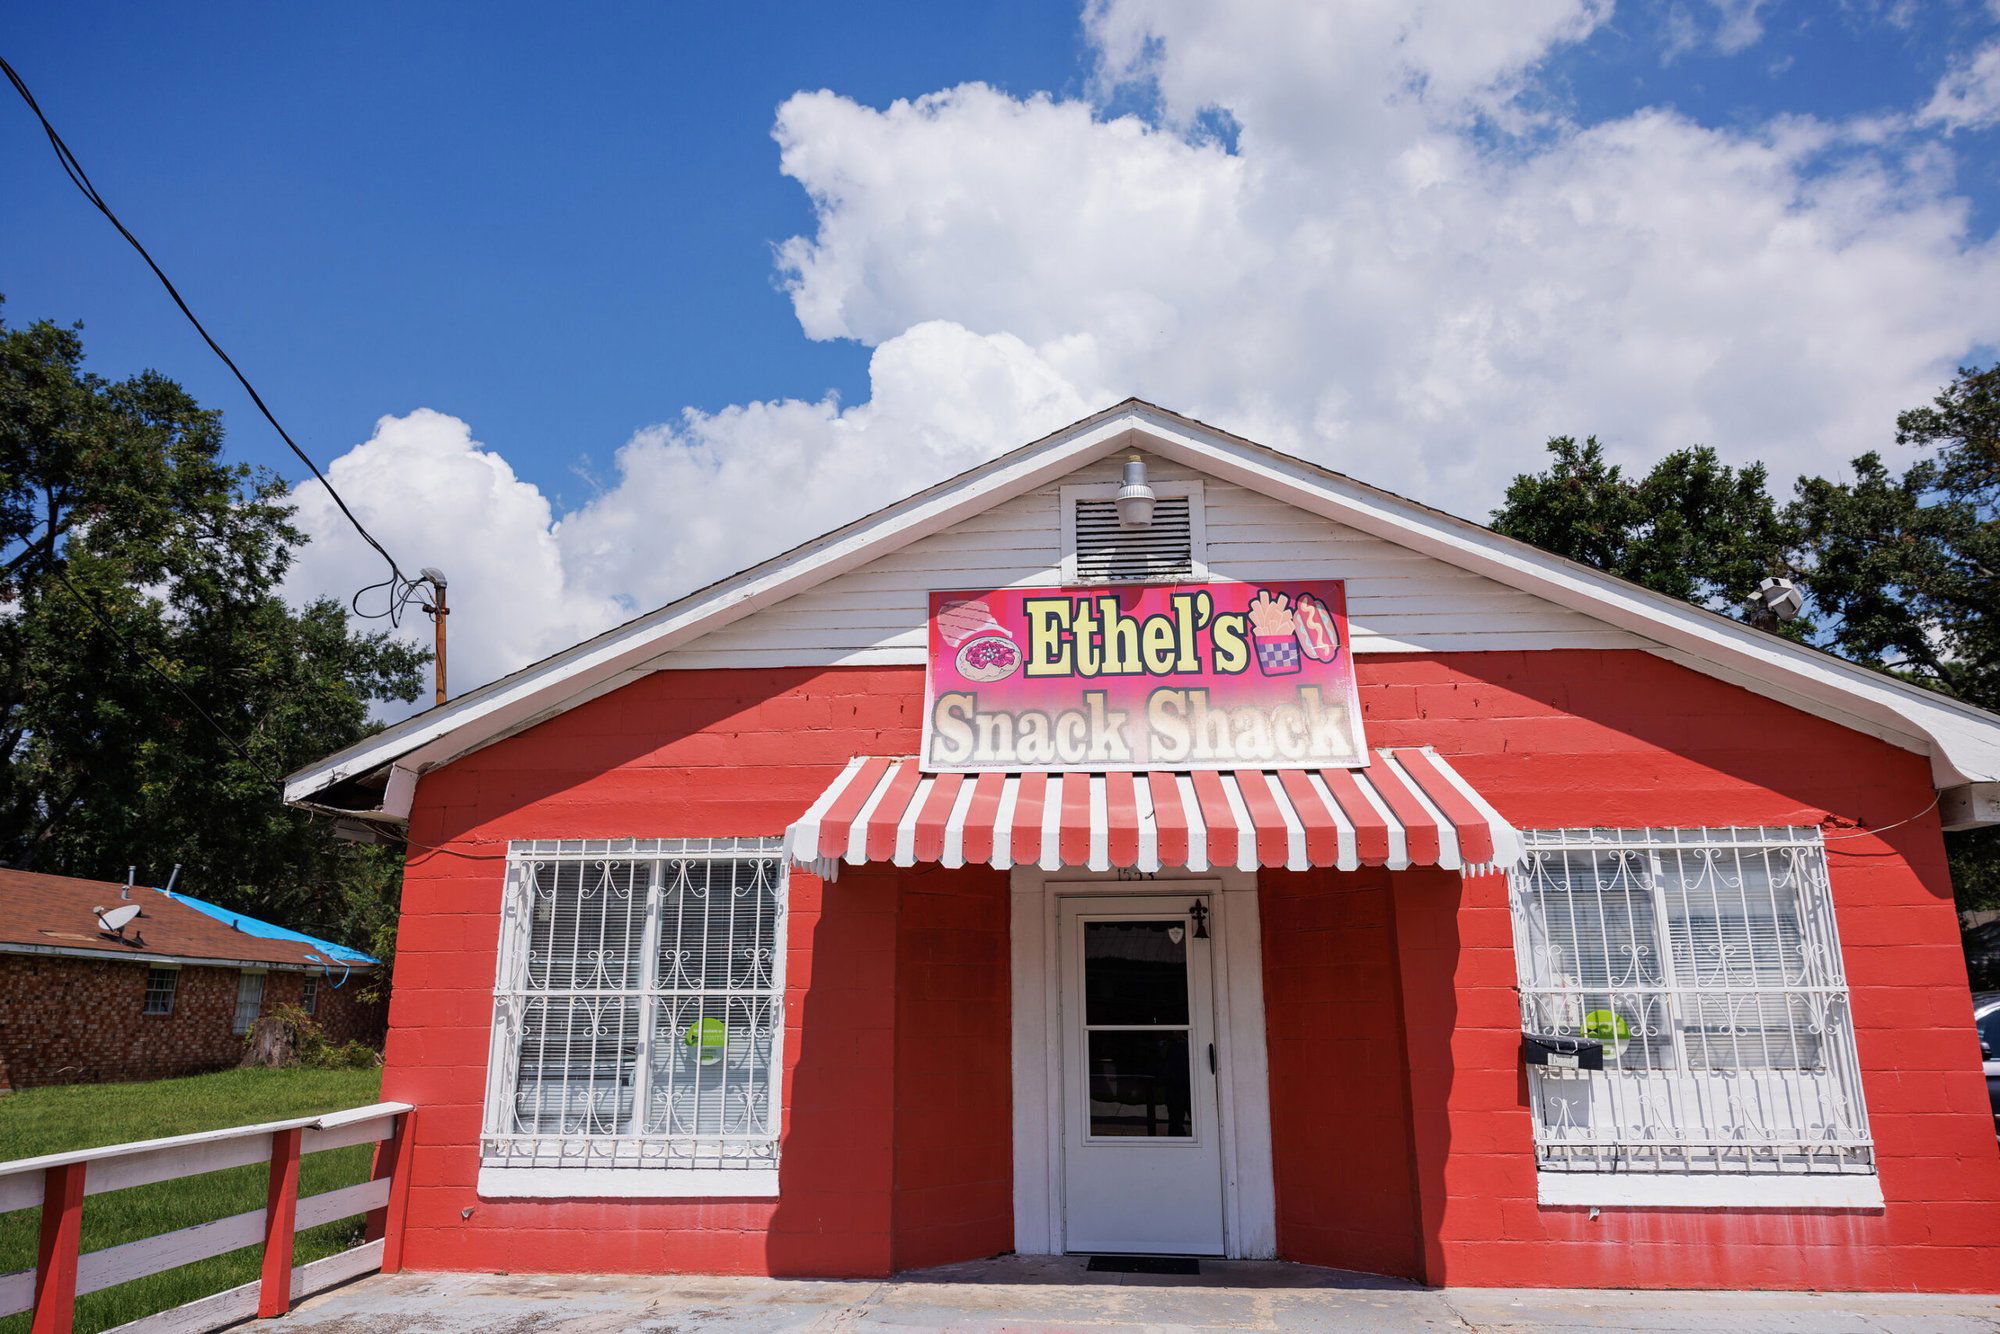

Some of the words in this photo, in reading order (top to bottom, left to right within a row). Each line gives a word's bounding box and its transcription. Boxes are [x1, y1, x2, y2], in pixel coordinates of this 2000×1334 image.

[1023, 590, 1249, 678] Ethel's
[931, 690, 1132, 763] Snack
[1146, 684, 1356, 763] Shack
